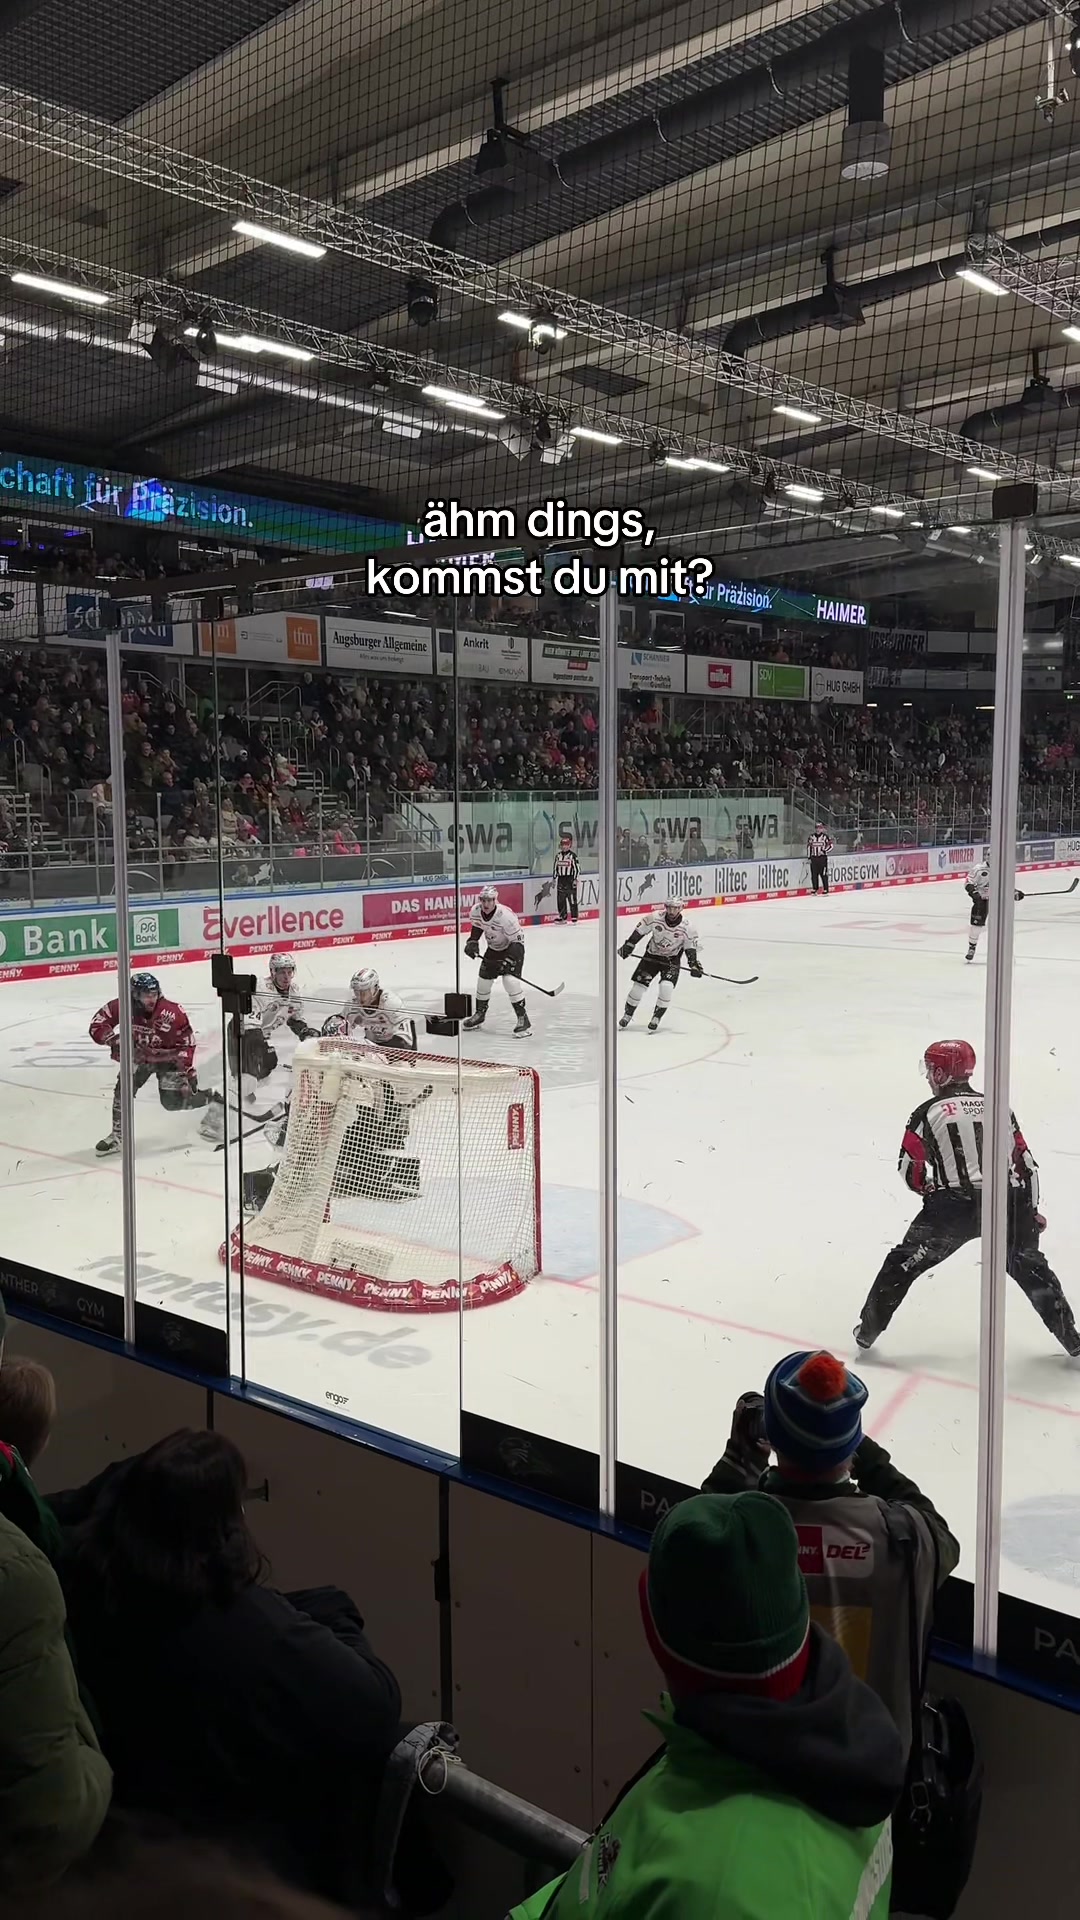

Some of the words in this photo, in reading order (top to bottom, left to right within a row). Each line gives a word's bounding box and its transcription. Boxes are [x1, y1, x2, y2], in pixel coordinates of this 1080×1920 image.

[84, 473, 123, 506] für
[132, 481, 254, 527] Präzision.
[333, 631, 381, 650] Augsburger
[383, 636, 427, 652] Allgemeine
[463, 636, 489, 649] Ankrit
[826, 680, 841, 692] HUG
[447, 822, 513, 854] swa
[653, 816, 702, 843] swa
[735, 813, 779, 840] swa
[391, 898, 420, 914] DAS
[203, 905, 344, 941] Everllence
[23, 918, 109, 956] Bank
[136, 934, 157, 943] Bank
[248, 1010, 261, 1020] 24
